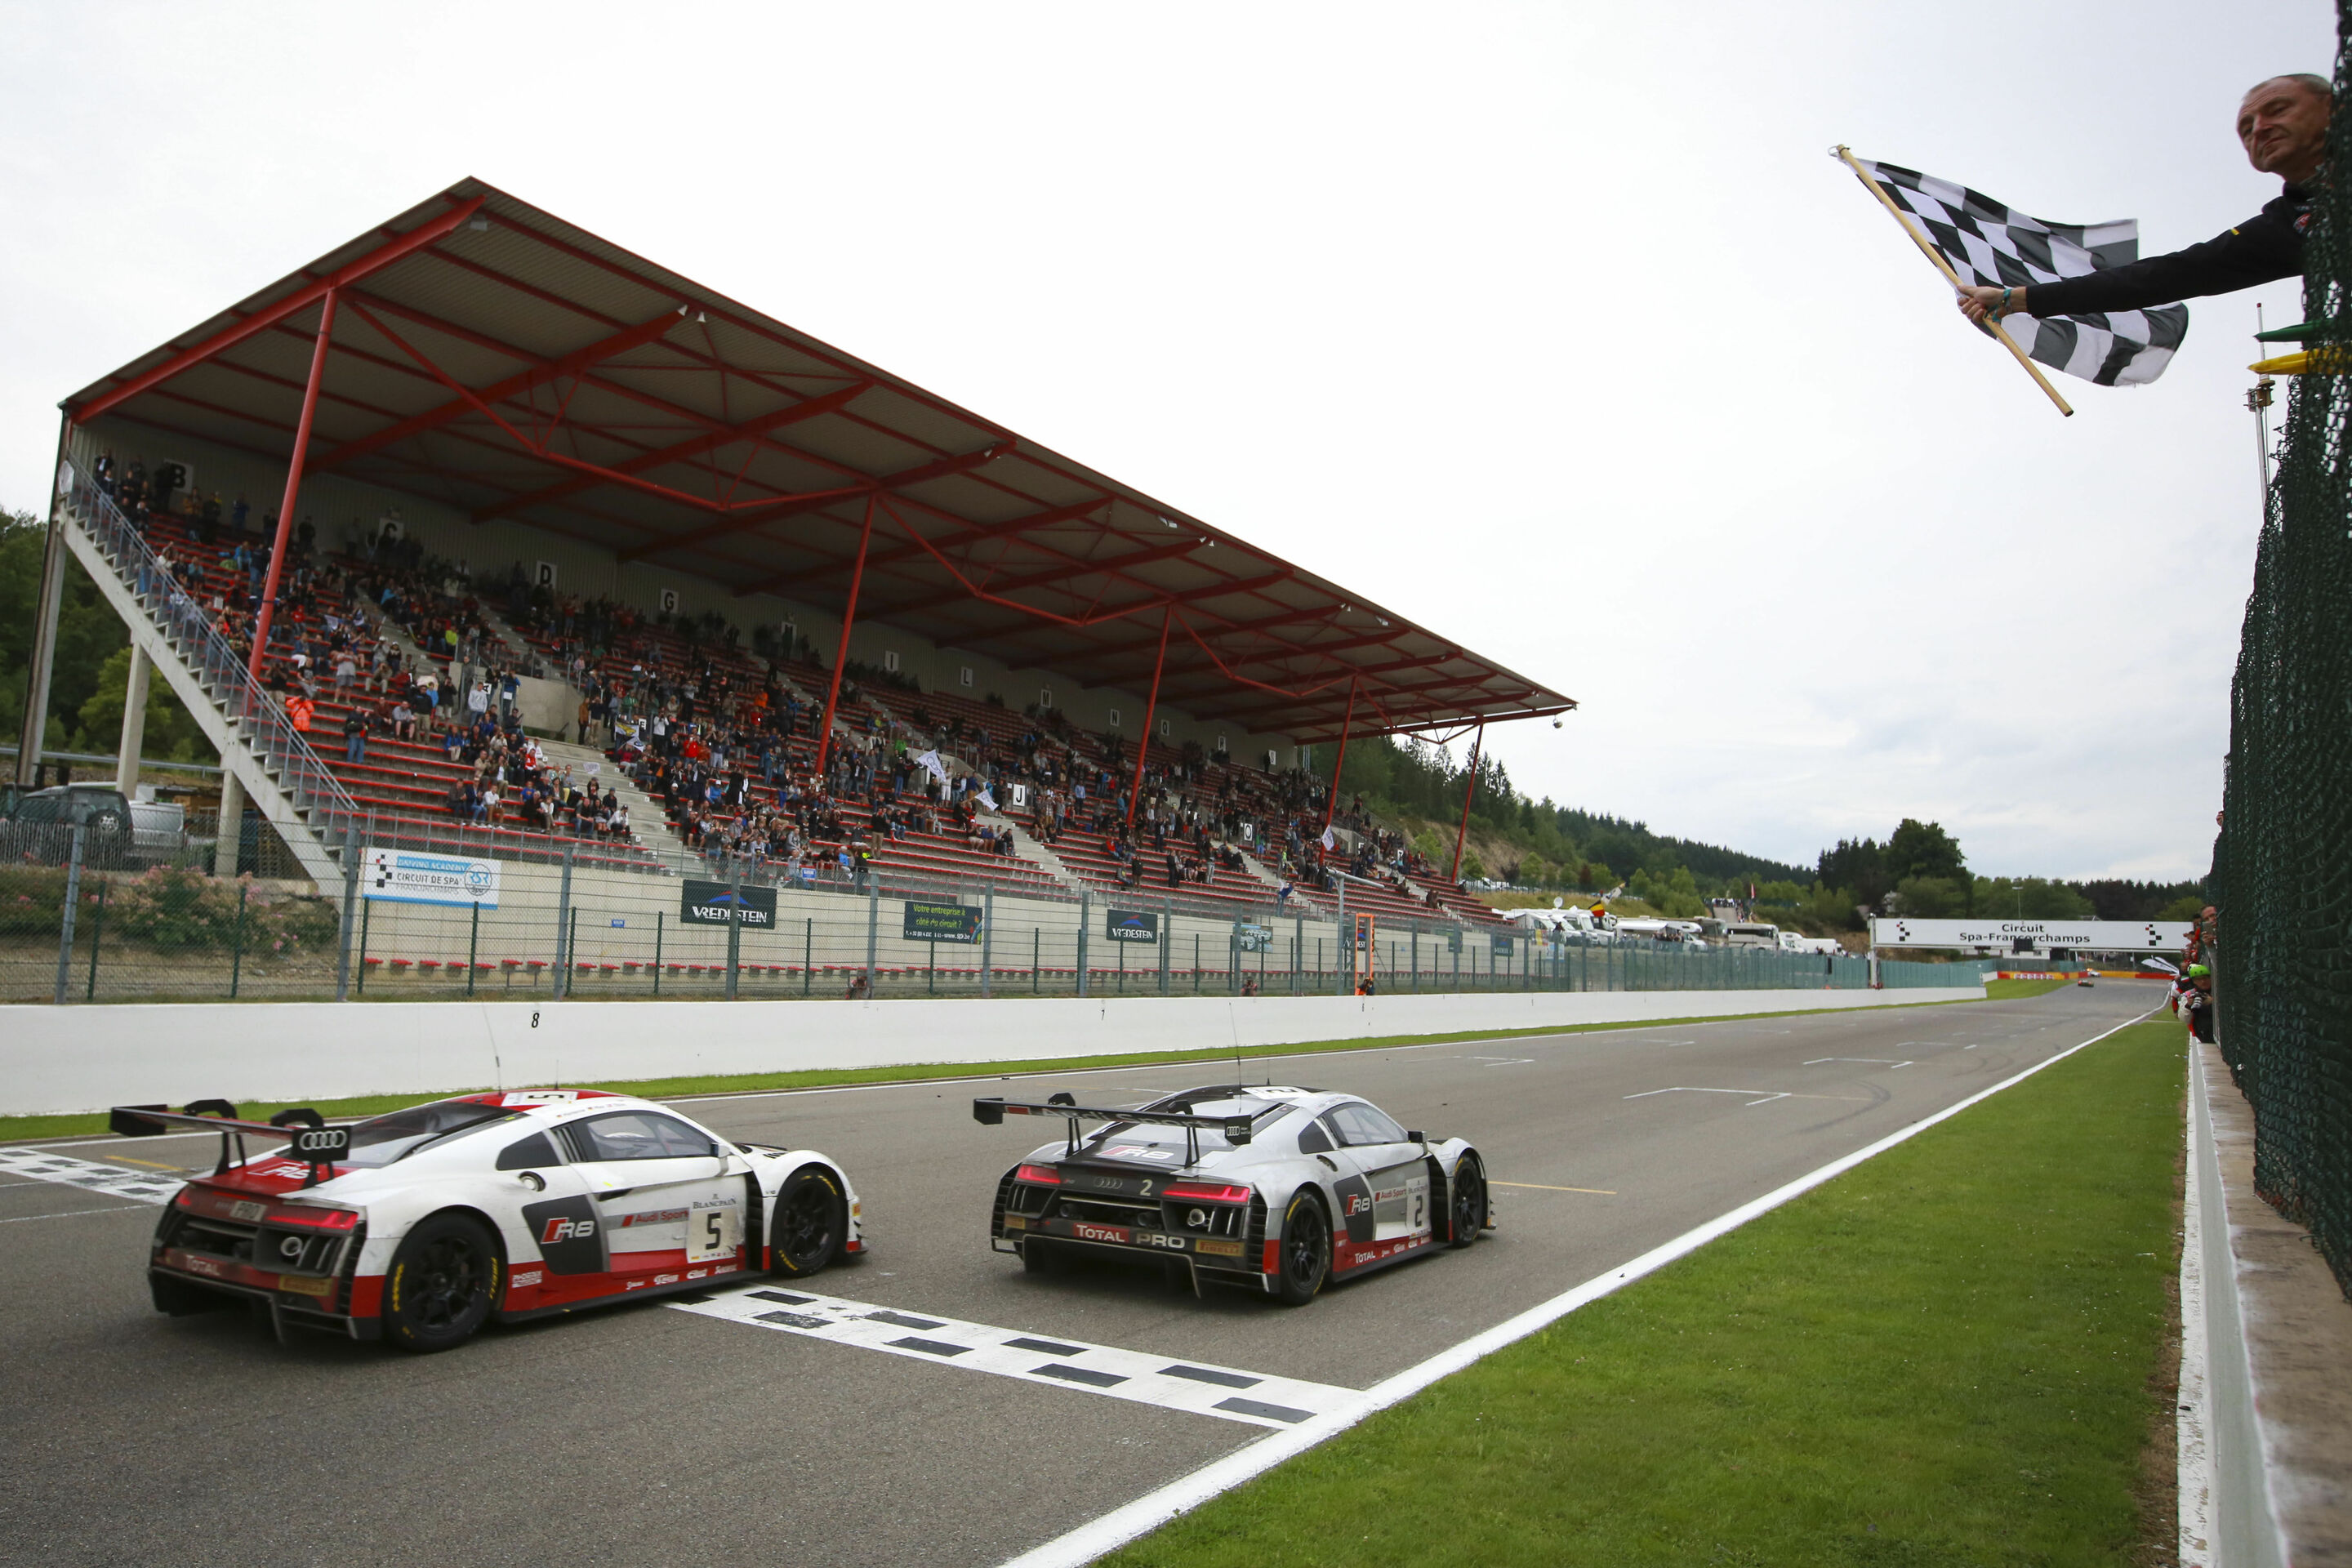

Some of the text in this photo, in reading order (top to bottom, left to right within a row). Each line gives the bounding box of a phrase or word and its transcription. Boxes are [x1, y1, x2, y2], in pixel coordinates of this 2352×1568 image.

[540, 564, 552, 585] D
[665, 592, 674, 611] G
[964, 670, 969, 684] L
[1042, 692, 1049, 706] M
[1111, 711, 1118, 725] N
[1016, 787, 1022, 804] J
[397, 872, 459, 885] CIRCUIT DE SPA
[692, 906, 768, 923] VREDTEIN
[913, 903, 930, 913] Votre
[931, 906, 960, 916] entreprise
[939, 920, 958, 929] circuit
[2002, 924, 2045, 933] Circuit
[531, 1012, 540, 1028] 8
[1139, 1179, 1153, 1196] 2
[1381, 1188, 1406, 1199] Audi Sport
[693, 1197, 737, 1209] BLANCPAIN
[1352, 1197, 1370, 1214] R8
[1415, 1194, 1423, 1227] 2
[635, 1209, 689, 1223] Audi Sport
[553, 1220, 595, 1240] R8
[706, 1212, 721, 1250] 5
[1076, 1224, 1125, 1243] TOTAL
[1136, 1234, 1185, 1249] PRO
[1355, 1250, 1376, 1264] TOTAL
[186, 1254, 220, 1276] TOTAL
